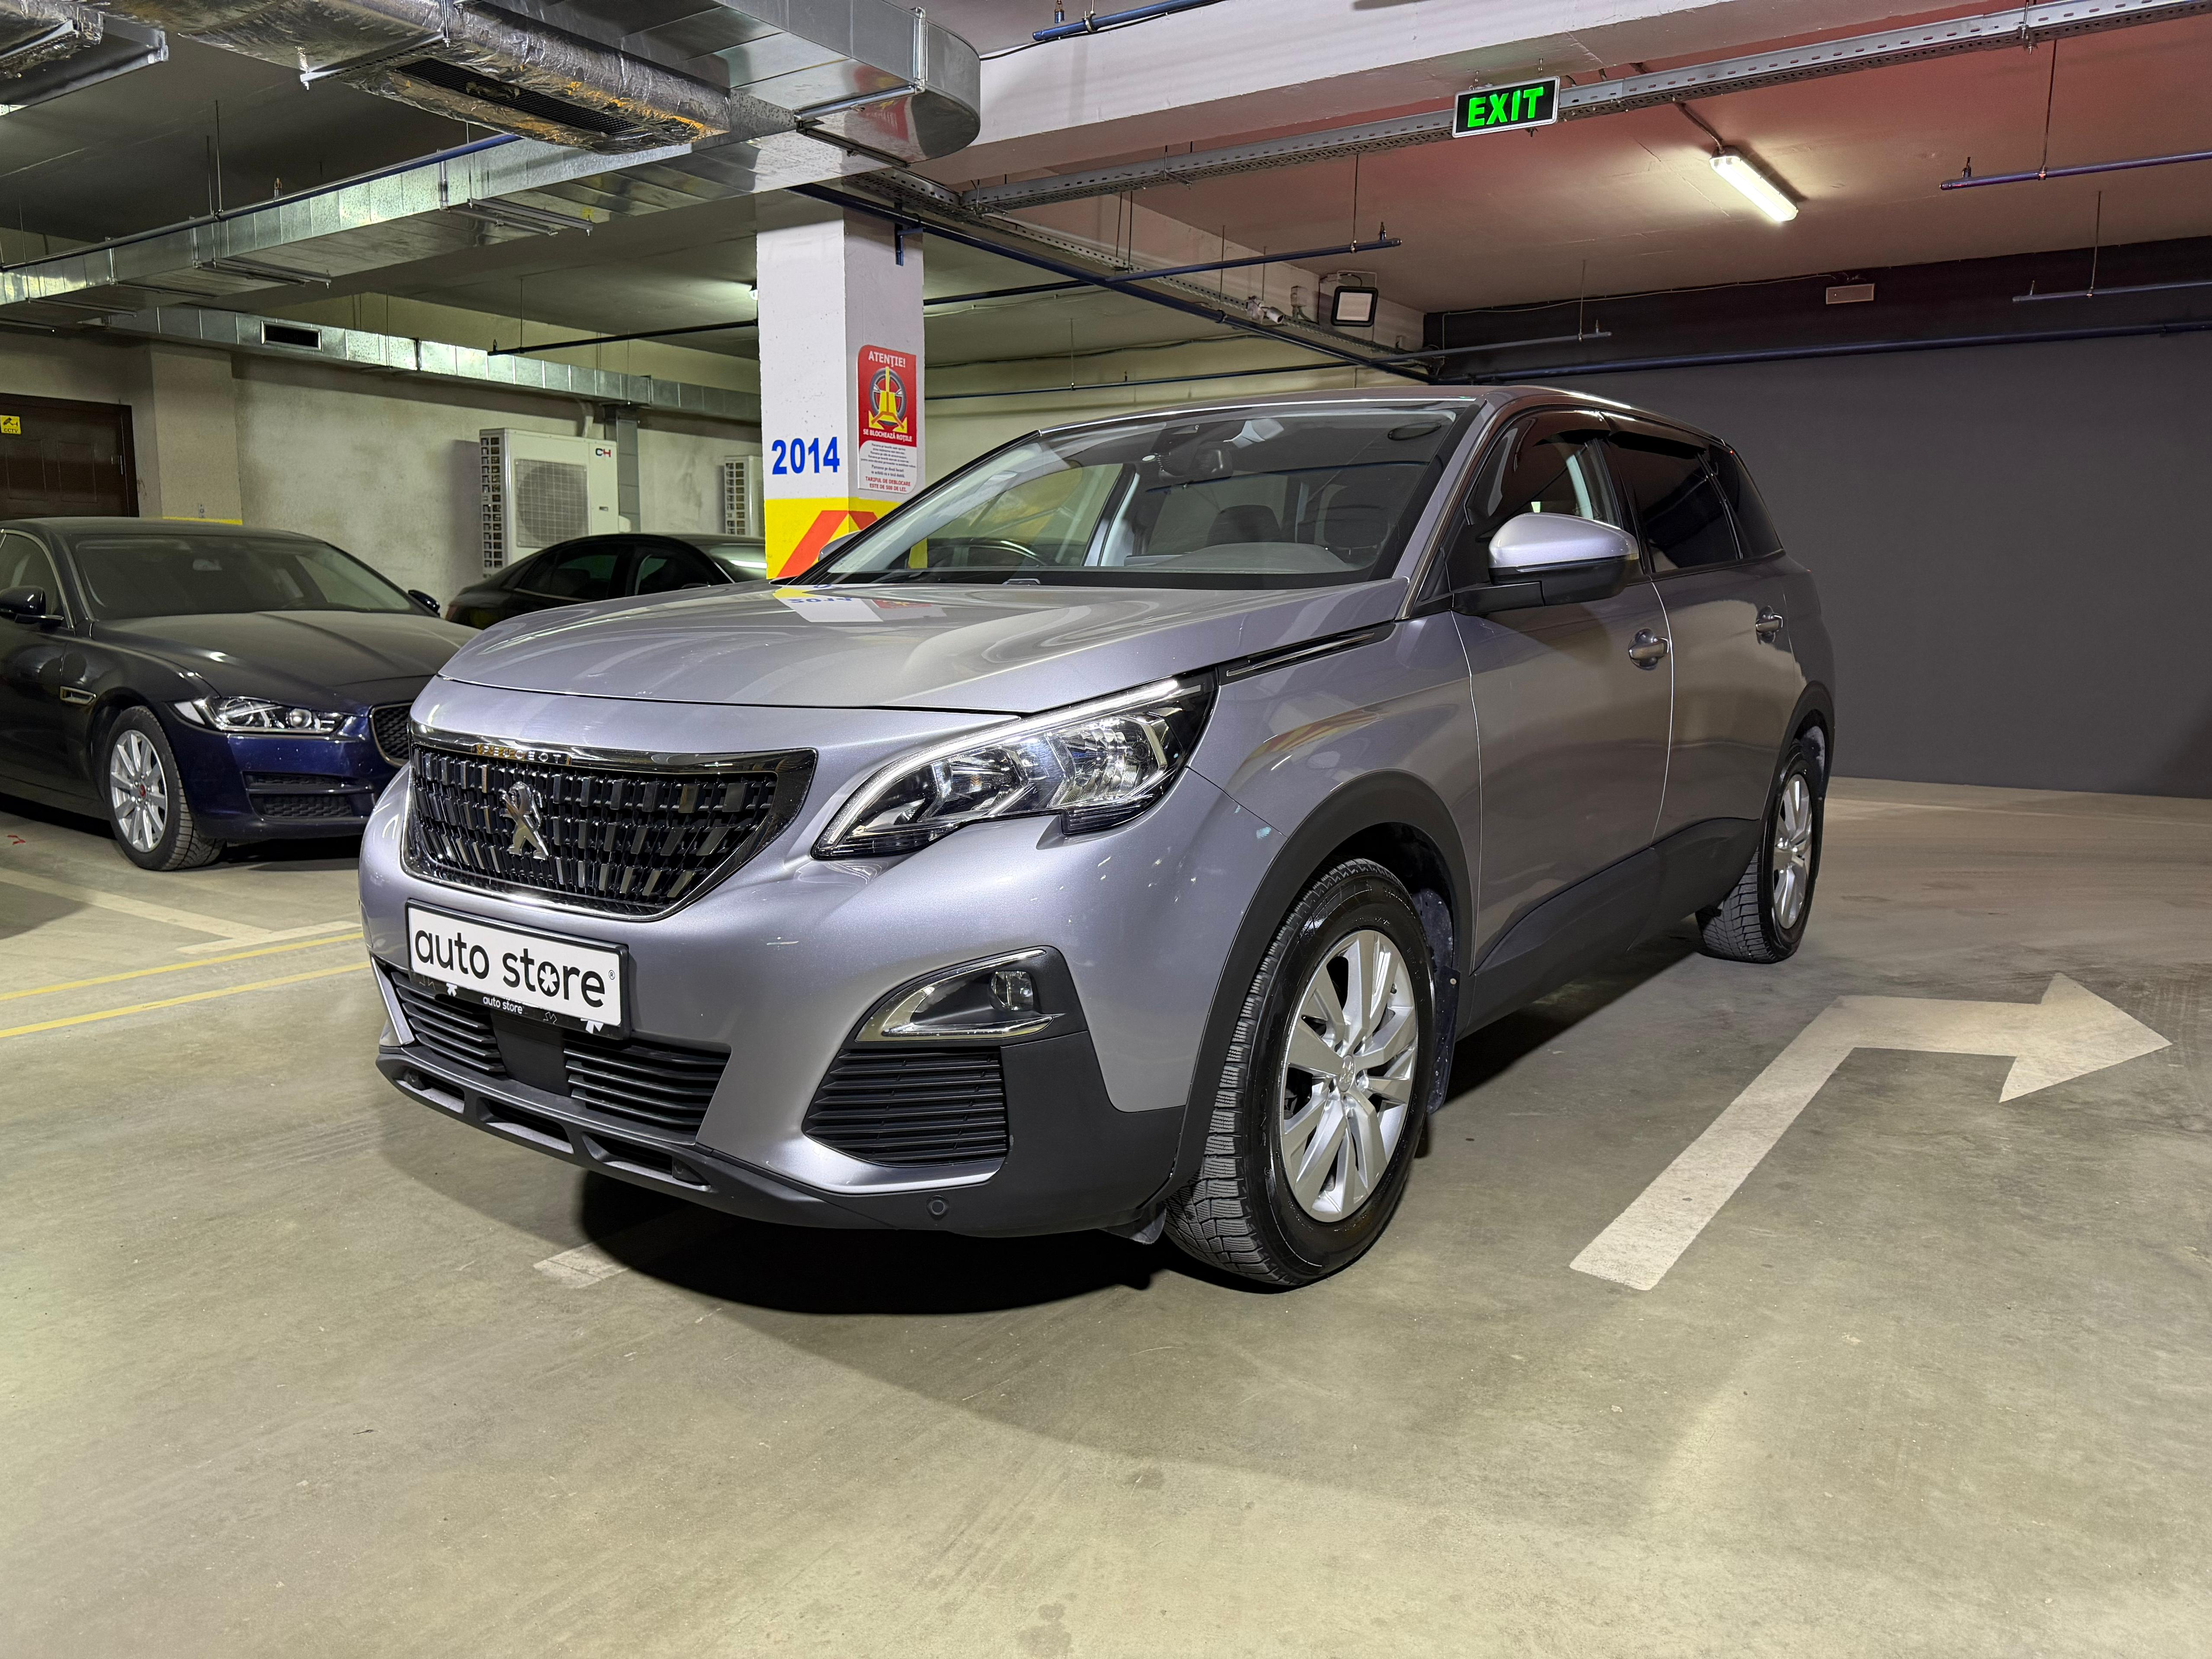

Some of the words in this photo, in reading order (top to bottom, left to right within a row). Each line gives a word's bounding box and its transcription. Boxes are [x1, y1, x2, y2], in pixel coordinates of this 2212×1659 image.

[1468, 86, 1544, 127] EXIT
[772, 437, 840, 475] 2014
[415, 930, 489, 979] auto
[483, 996, 501, 1008] auto
[502, 1001, 523, 1014] store
